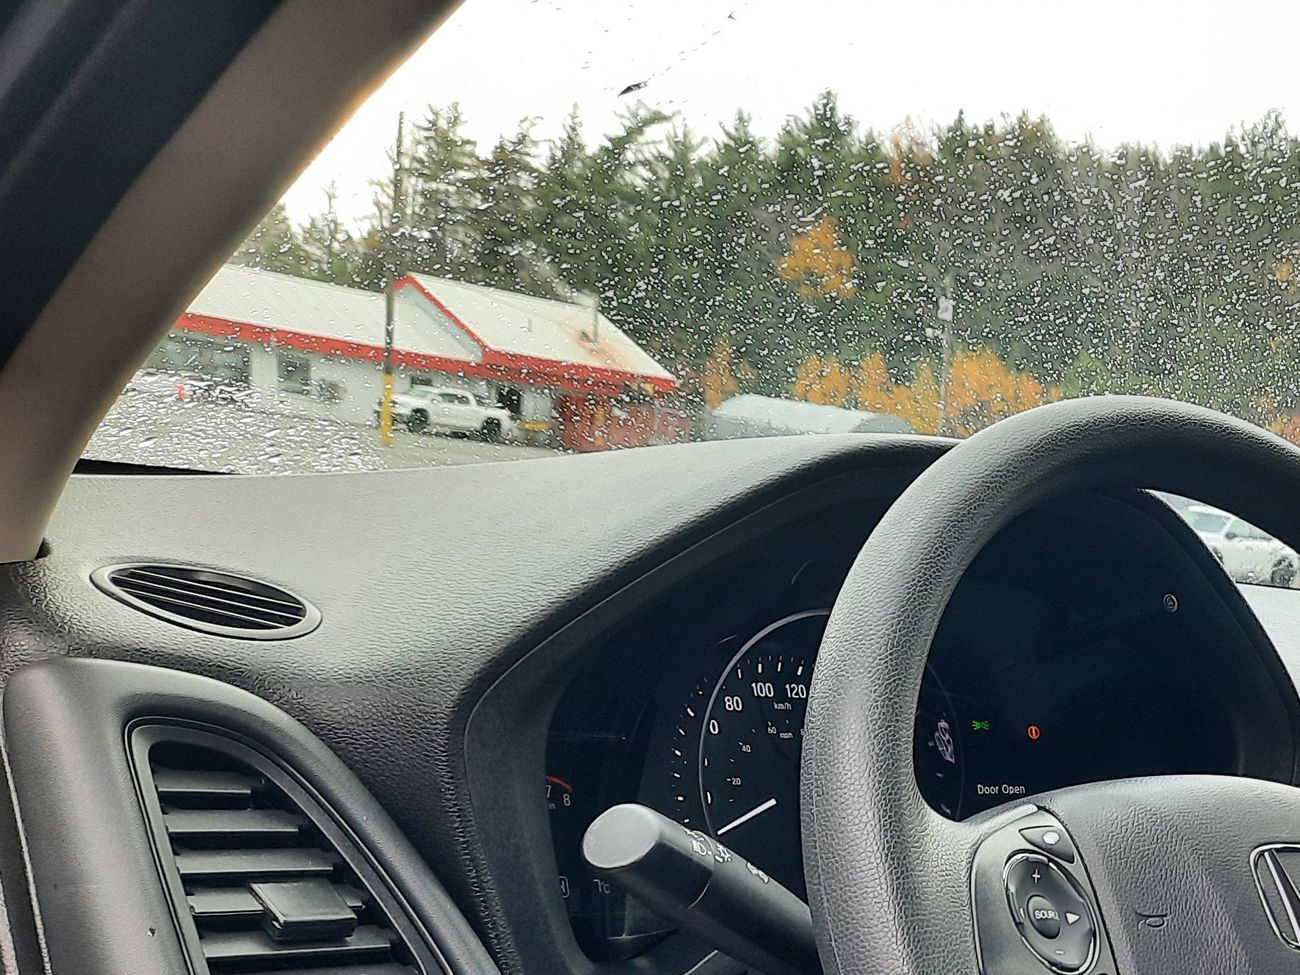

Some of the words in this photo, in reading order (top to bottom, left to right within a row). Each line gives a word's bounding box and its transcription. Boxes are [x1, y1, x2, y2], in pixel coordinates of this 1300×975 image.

[751, 682, 774, 698] 100
[785, 684, 807, 699] 120
[724, 696, 743, 711] 80
[773, 701, 793, 711] km/h
[767, 726, 777, 735] 60
[731, 777, 742, 786] 20
[977, 784, 999, 795] Door
[1001, 784, 1026, 795] Open
[562, 793, 571, 807] 8
